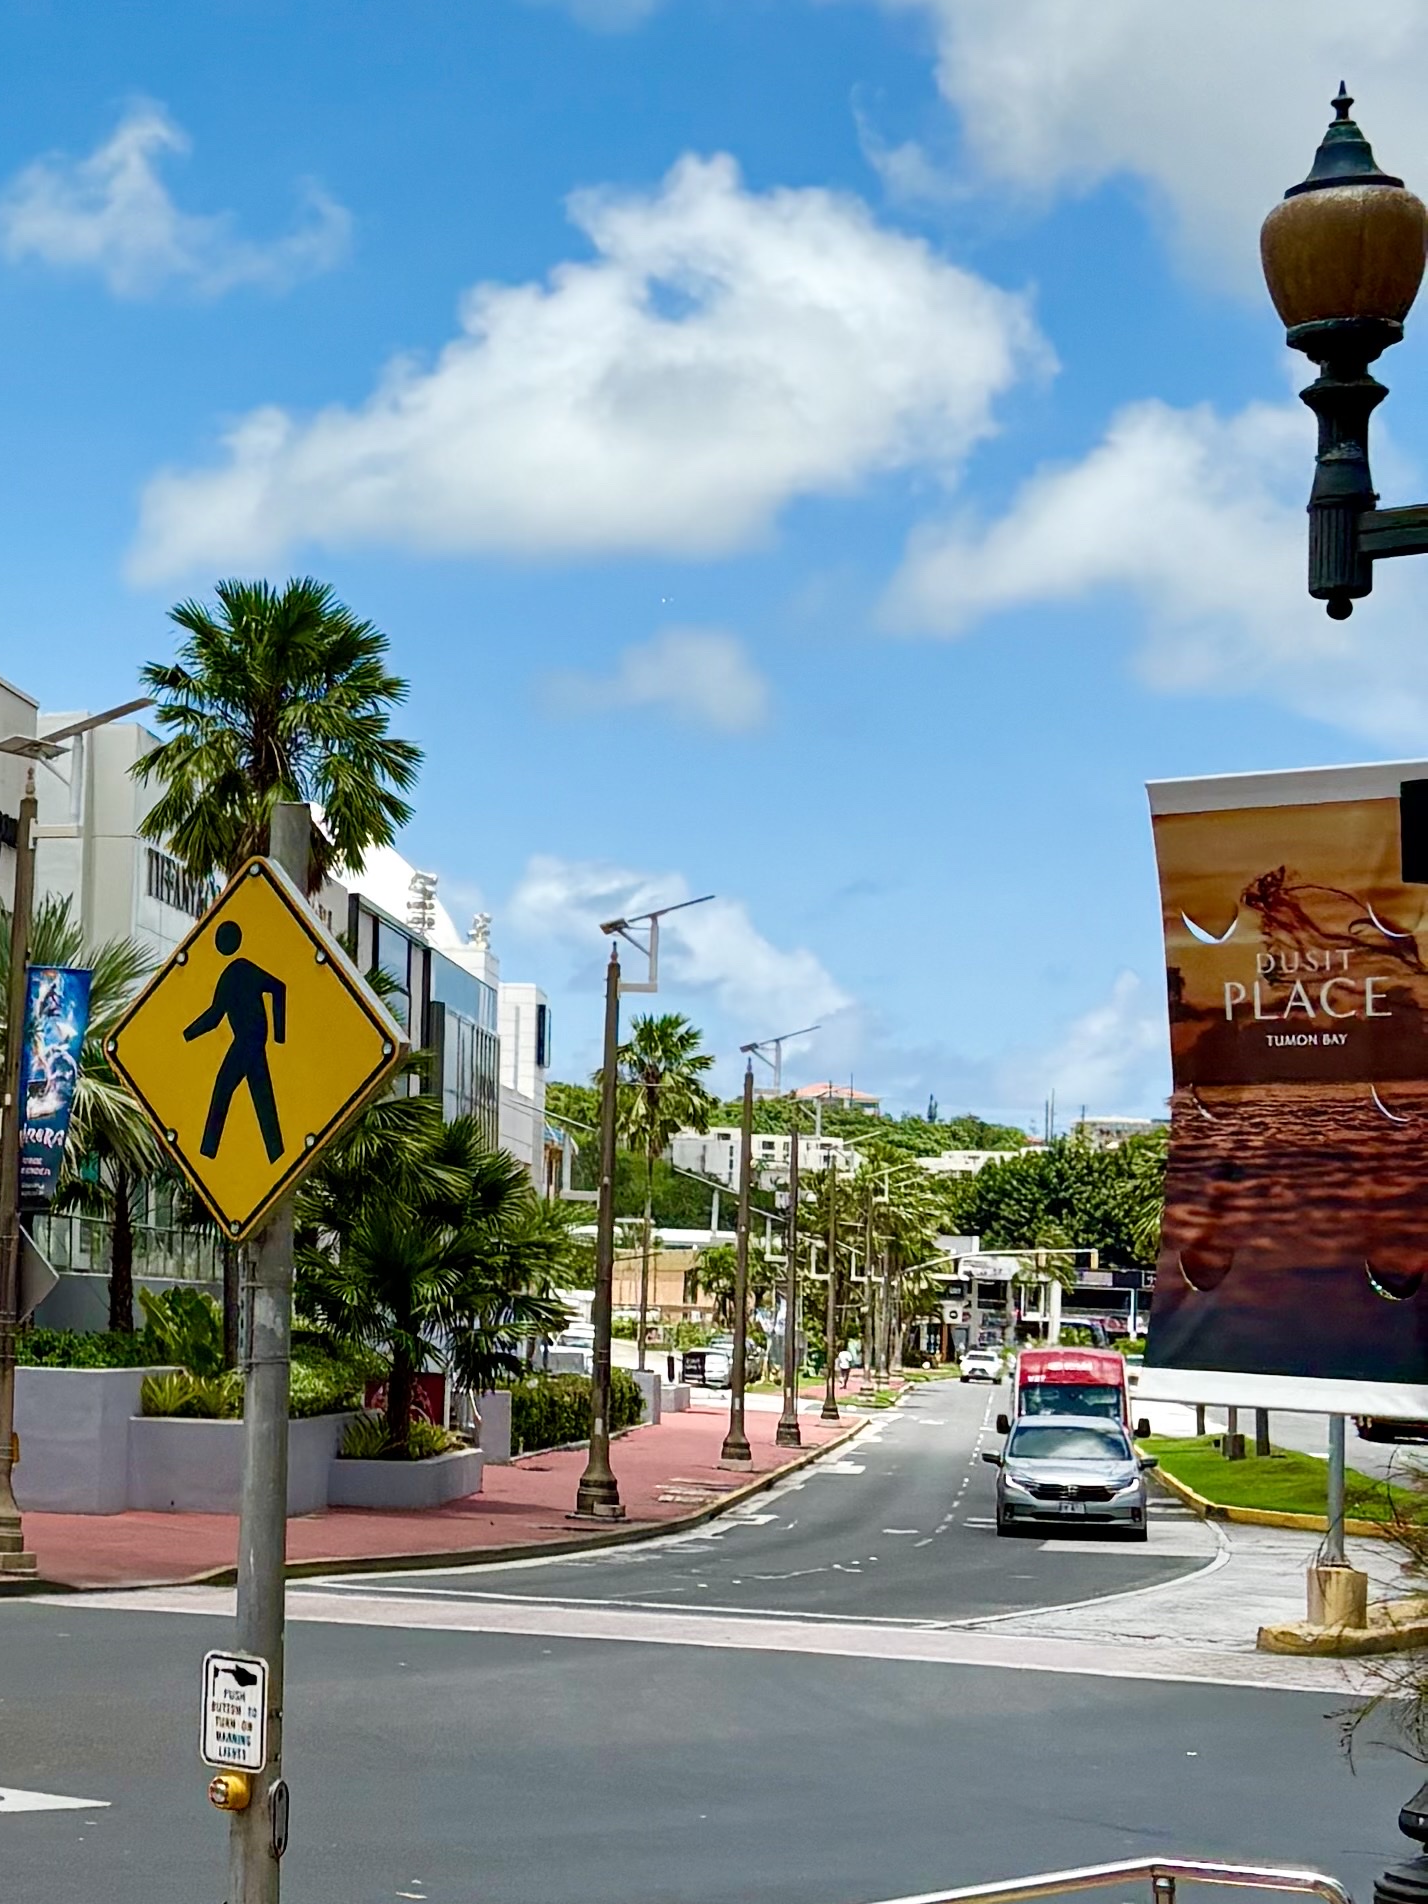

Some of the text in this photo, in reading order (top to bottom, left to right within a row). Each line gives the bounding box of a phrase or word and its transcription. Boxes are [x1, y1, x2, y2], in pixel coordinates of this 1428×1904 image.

[1256, 949, 1356, 974] DUSIT
[1224, 976, 1393, 1021] PLACE
[1265, 1033, 1348, 1047] TUMON BAY
[224, 1688, 246, 1703] PUSH
[211, 1700, 257, 1718] BUTTON TO
[215, 1715, 236, 1729] TURN
